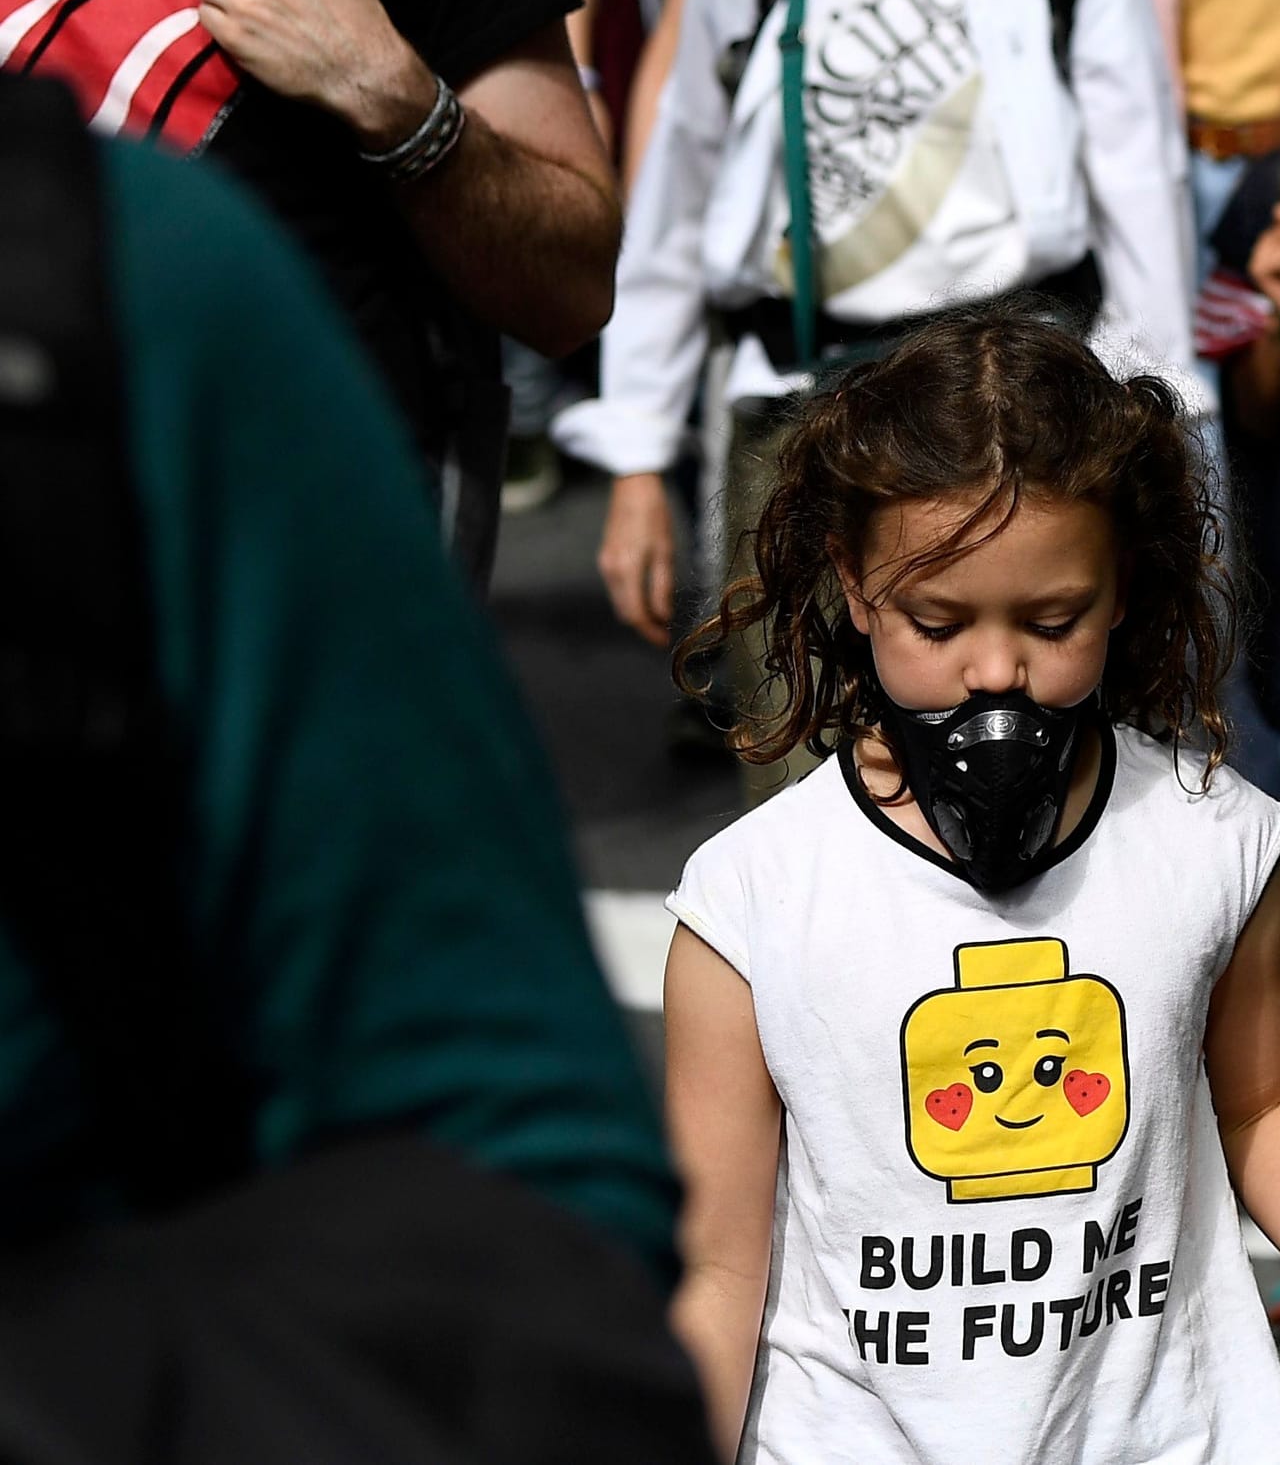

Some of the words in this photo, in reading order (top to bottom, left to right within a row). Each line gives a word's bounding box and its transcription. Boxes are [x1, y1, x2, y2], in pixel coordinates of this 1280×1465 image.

[859, 1227, 1053, 1291] BUILD
[1082, 1197, 1144, 1275] ME
[841, 1307, 931, 1366] HE
[961, 1260, 1171, 1361] FUTURE
